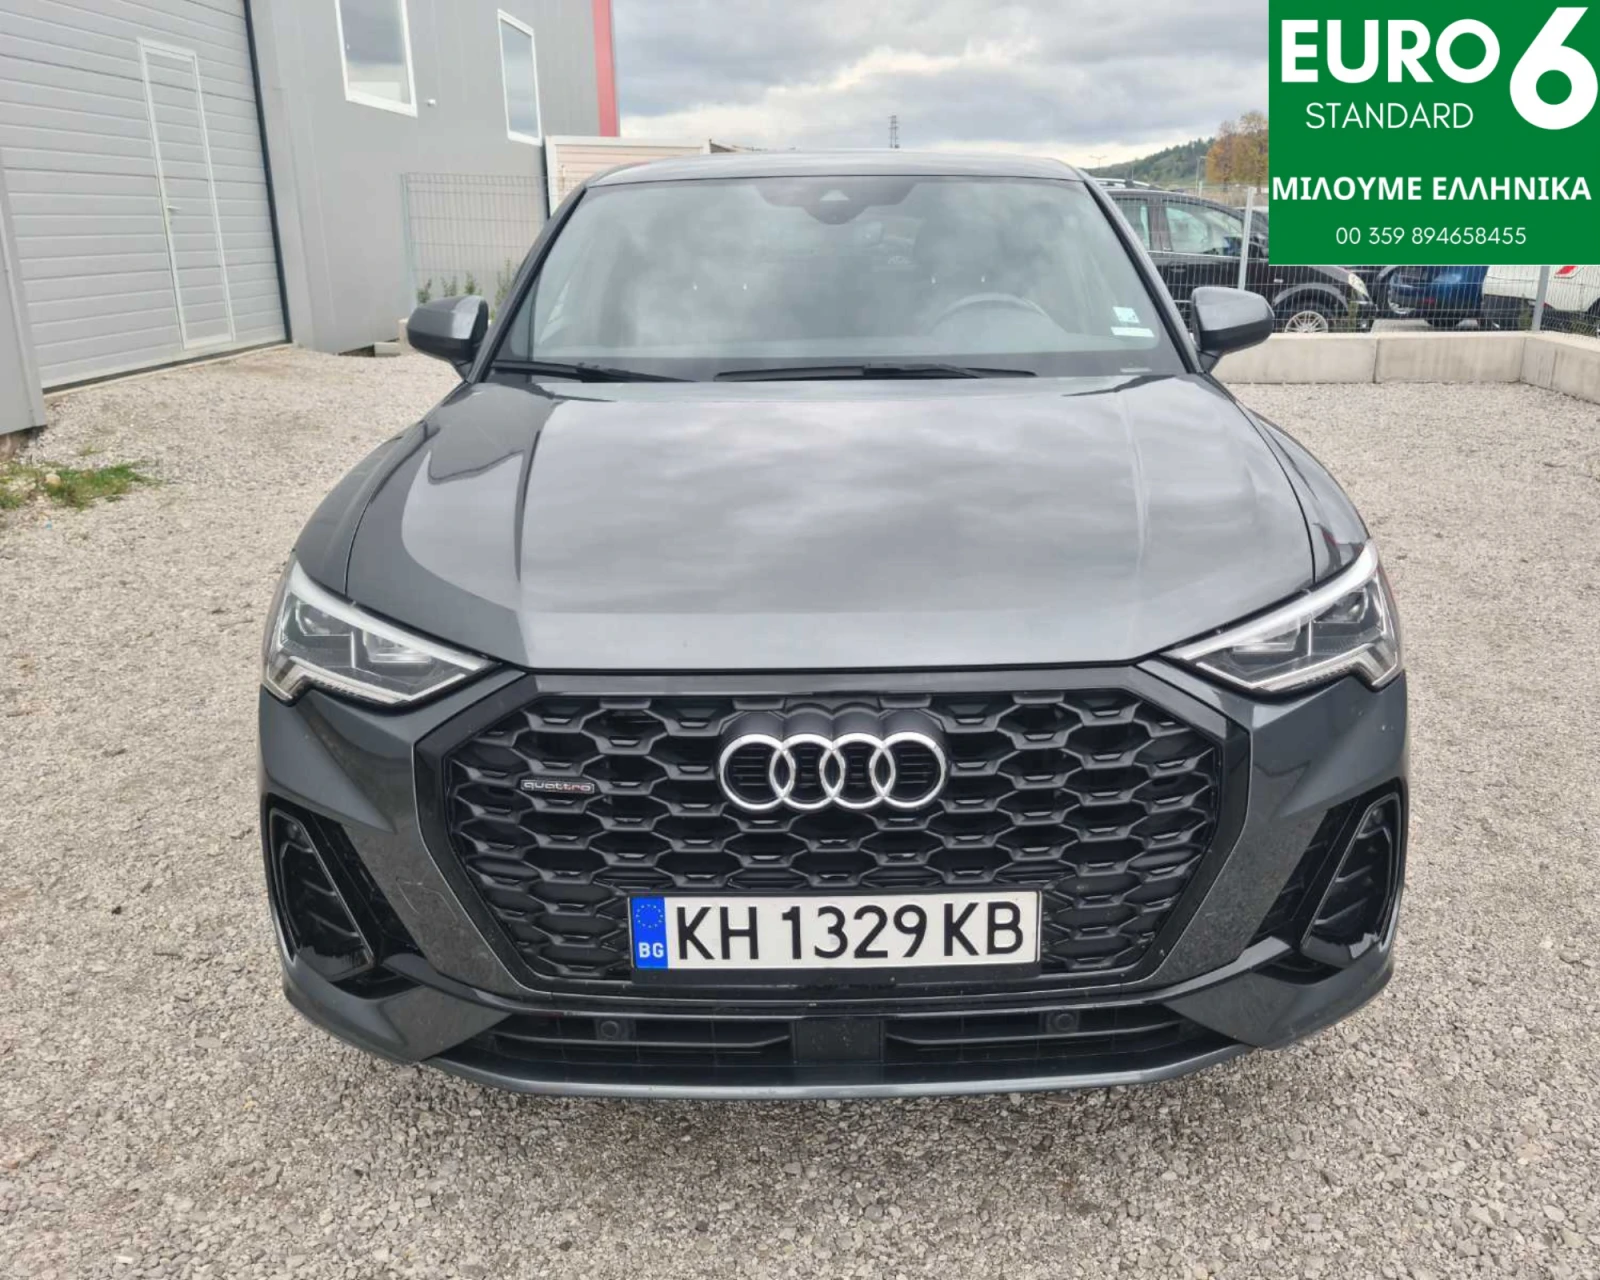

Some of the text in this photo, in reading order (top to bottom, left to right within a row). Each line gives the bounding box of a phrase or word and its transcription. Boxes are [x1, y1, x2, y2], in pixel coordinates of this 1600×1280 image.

[523, 782, 592, 792] quattro
[676, 900, 1024, 960] KH 1329 KB
[638, 941, 665, 959] BG
